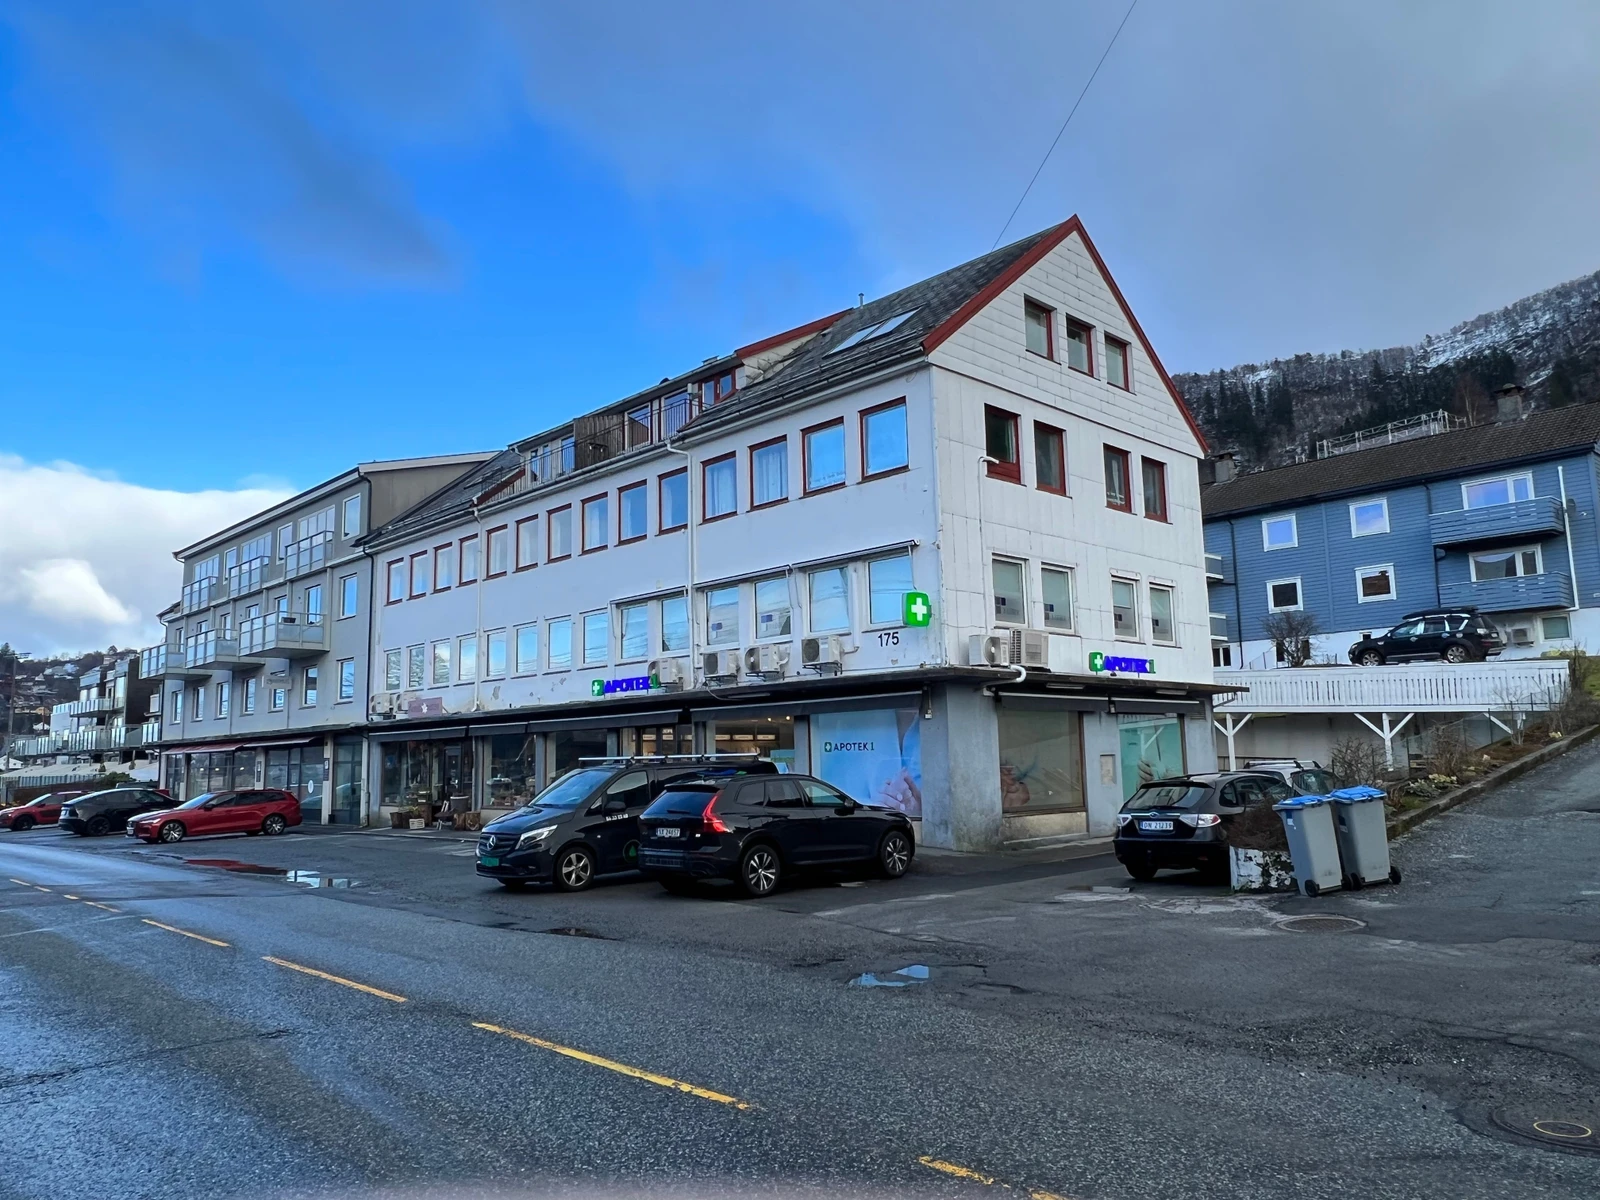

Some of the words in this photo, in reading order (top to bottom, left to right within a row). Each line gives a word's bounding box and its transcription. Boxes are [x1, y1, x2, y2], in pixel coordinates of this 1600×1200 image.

[877, 631, 900, 647] 175
[833, 742, 869, 751] APOTEK
[870, 742, 875, 751] 1
